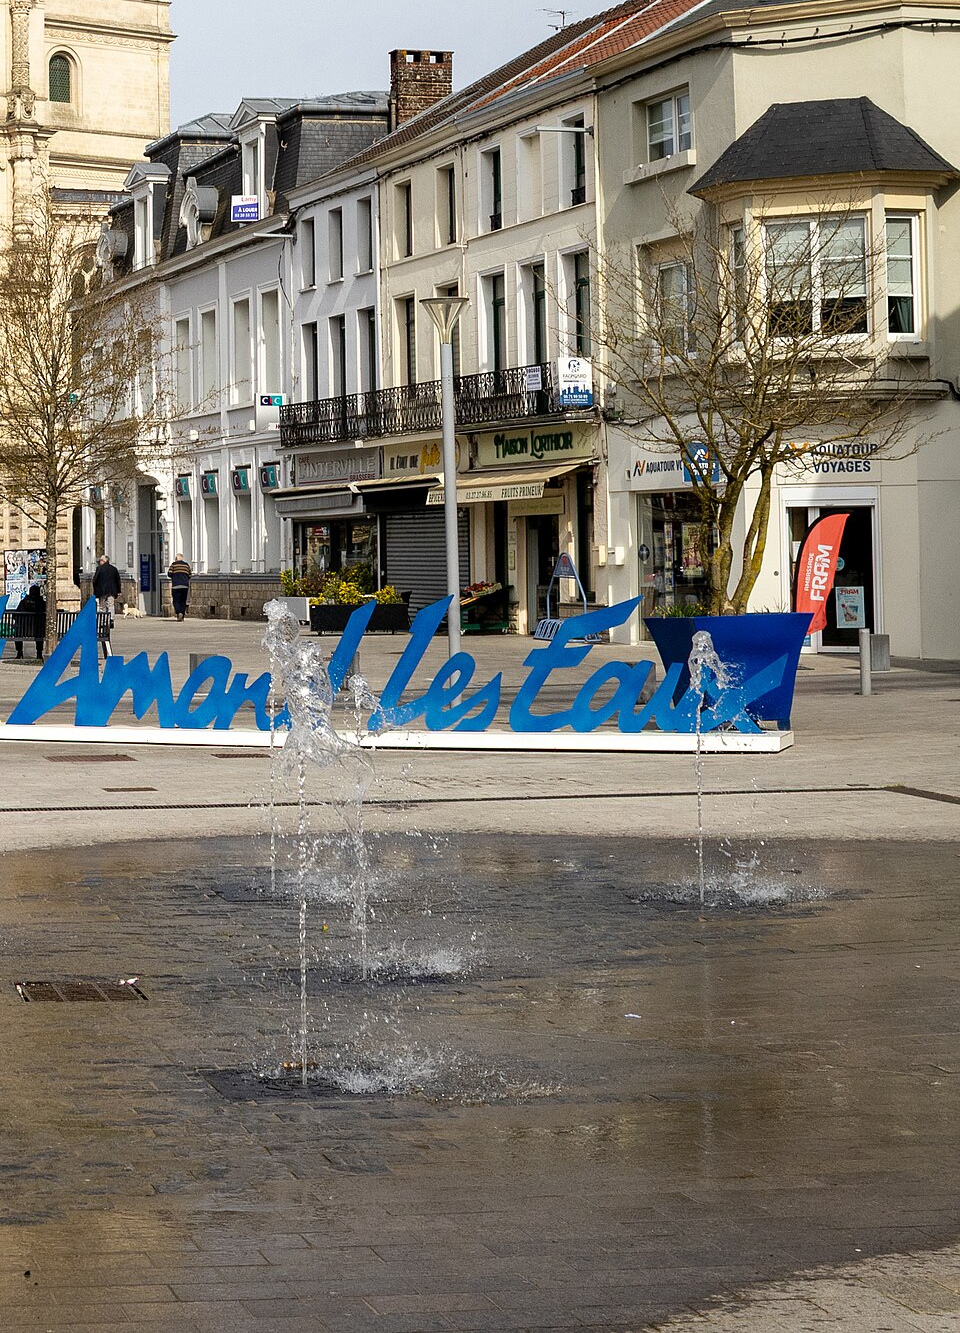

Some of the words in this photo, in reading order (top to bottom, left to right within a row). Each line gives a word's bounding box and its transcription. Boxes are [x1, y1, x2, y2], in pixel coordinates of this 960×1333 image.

[261, 396, 281, 406] CIC
[299, 456, 376, 480] L'INTERVILLE
[646, 460, 676, 474] AQUATOUR
[813, 460, 871, 474] VOYAGES
[349, 473, 376, 482] BRASSERIE
[501, 487, 519, 498] FRUITS
[804, 552, 815, 592] AMBASSADE
[810, 544, 834, 601] FRAM
[509, 595, 789, 735] Eaux
